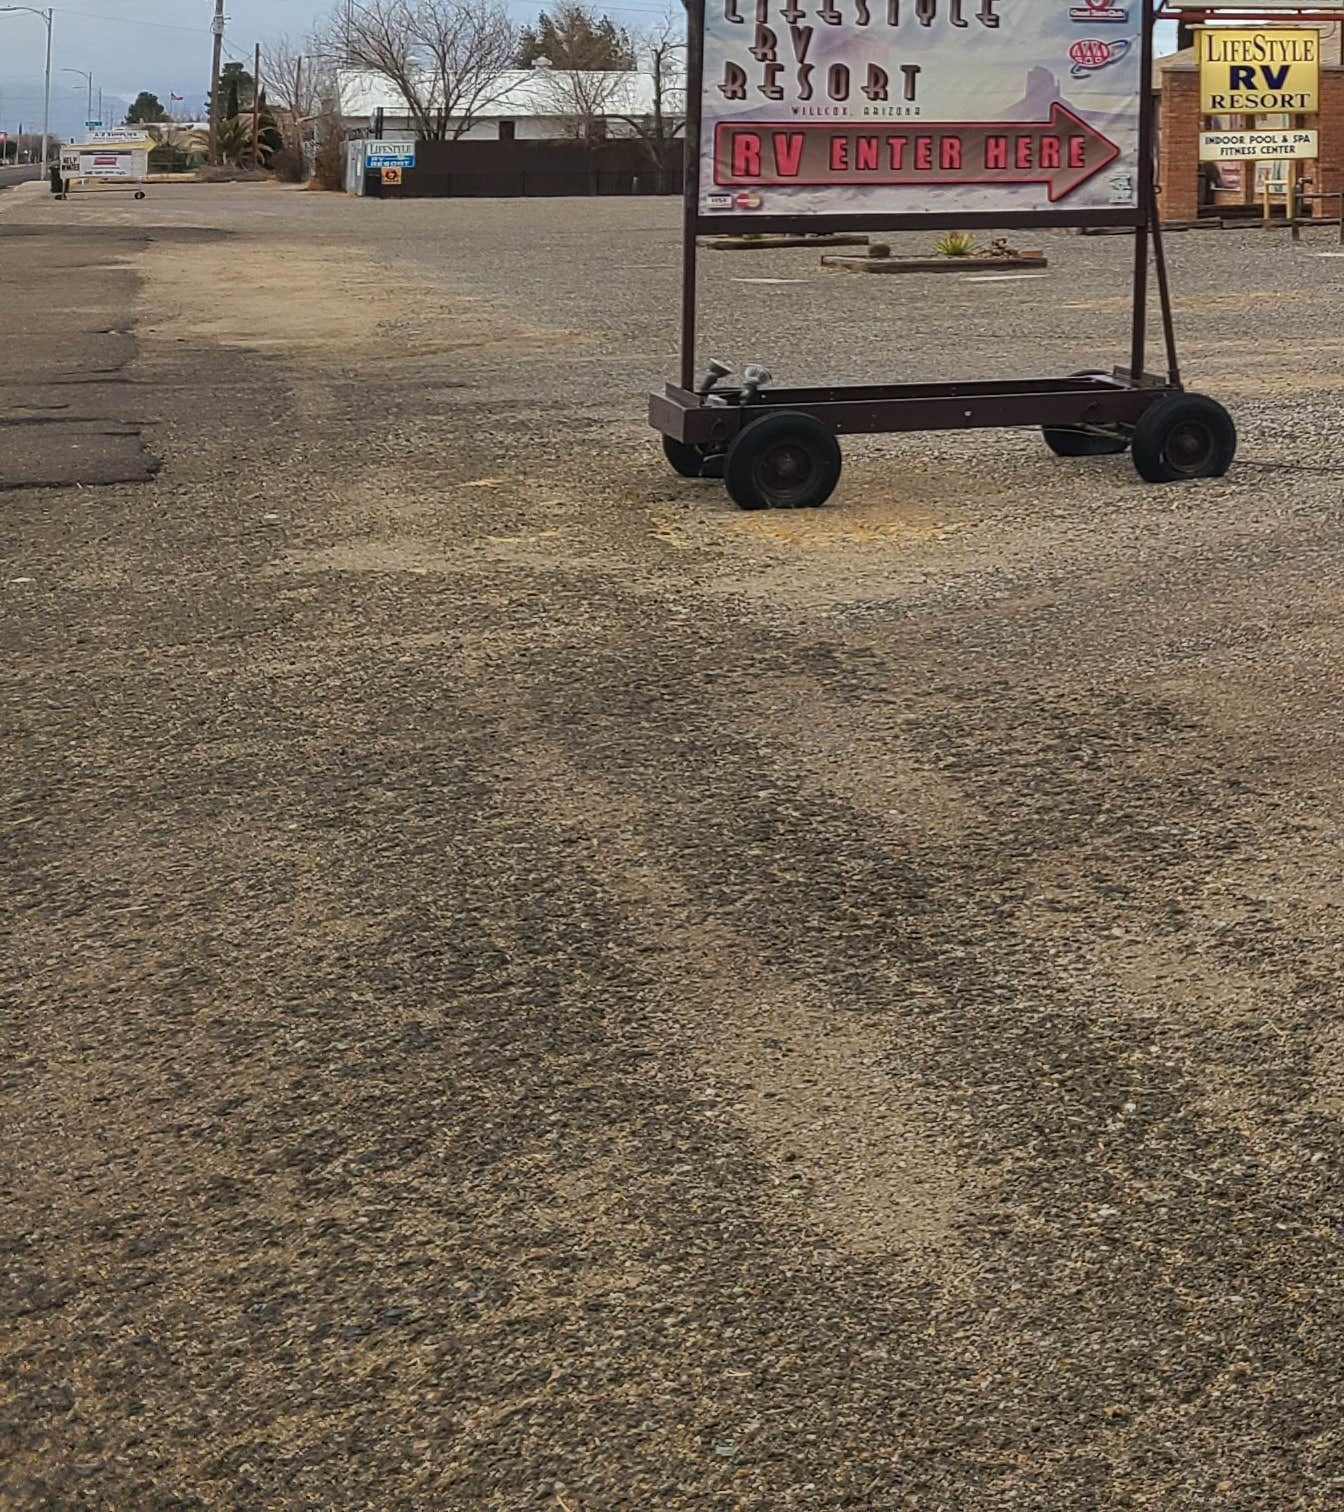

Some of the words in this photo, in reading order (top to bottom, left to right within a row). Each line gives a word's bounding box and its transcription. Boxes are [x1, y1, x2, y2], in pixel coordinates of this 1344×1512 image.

[748, 23, 814, 64] RV
[717, 60, 922, 102] RESORT
[1229, 65, 1291, 91] RV
[863, 106, 921, 116] ARIZONA
[1210, 93, 1311, 109] RESORT
[1205, 135, 1245, 145] INDOOR
[1249, 135, 1277, 144] POOL
[1281, 135, 1288, 144] &
[1292, 134, 1311, 143] SPA
[731, 131, 805, 177] RV
[829, 136, 962, 171] ENTER
[985, 135, 1086, 169] HERE
[1220, 147, 1256, 156] FITNESS
[1260, 145, 1296, 154] CENTER
